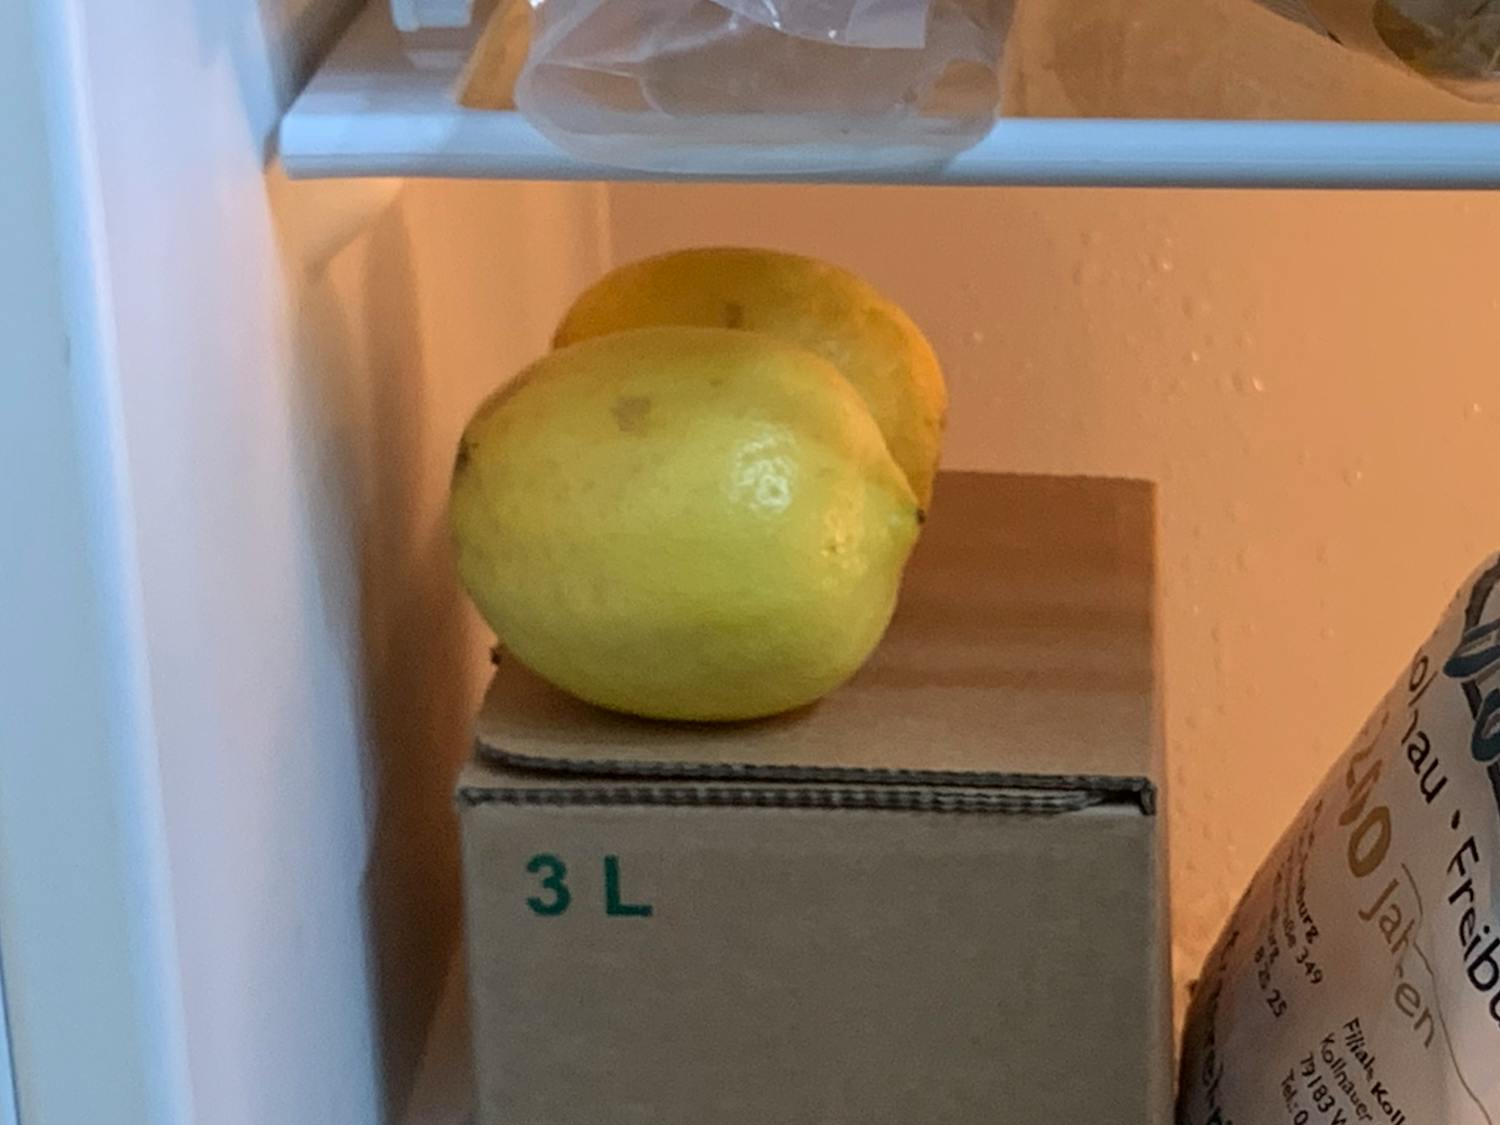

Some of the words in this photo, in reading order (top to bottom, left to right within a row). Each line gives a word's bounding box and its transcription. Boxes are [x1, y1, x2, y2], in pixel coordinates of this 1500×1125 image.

[525, 853, 572, 917] 3
[604, 854, 654, 918] L
[1295, 947, 1325, 986] 349
[1265, 988, 1288, 1019] 25
[1320, 1032, 1374, 1123] Kollnauer
